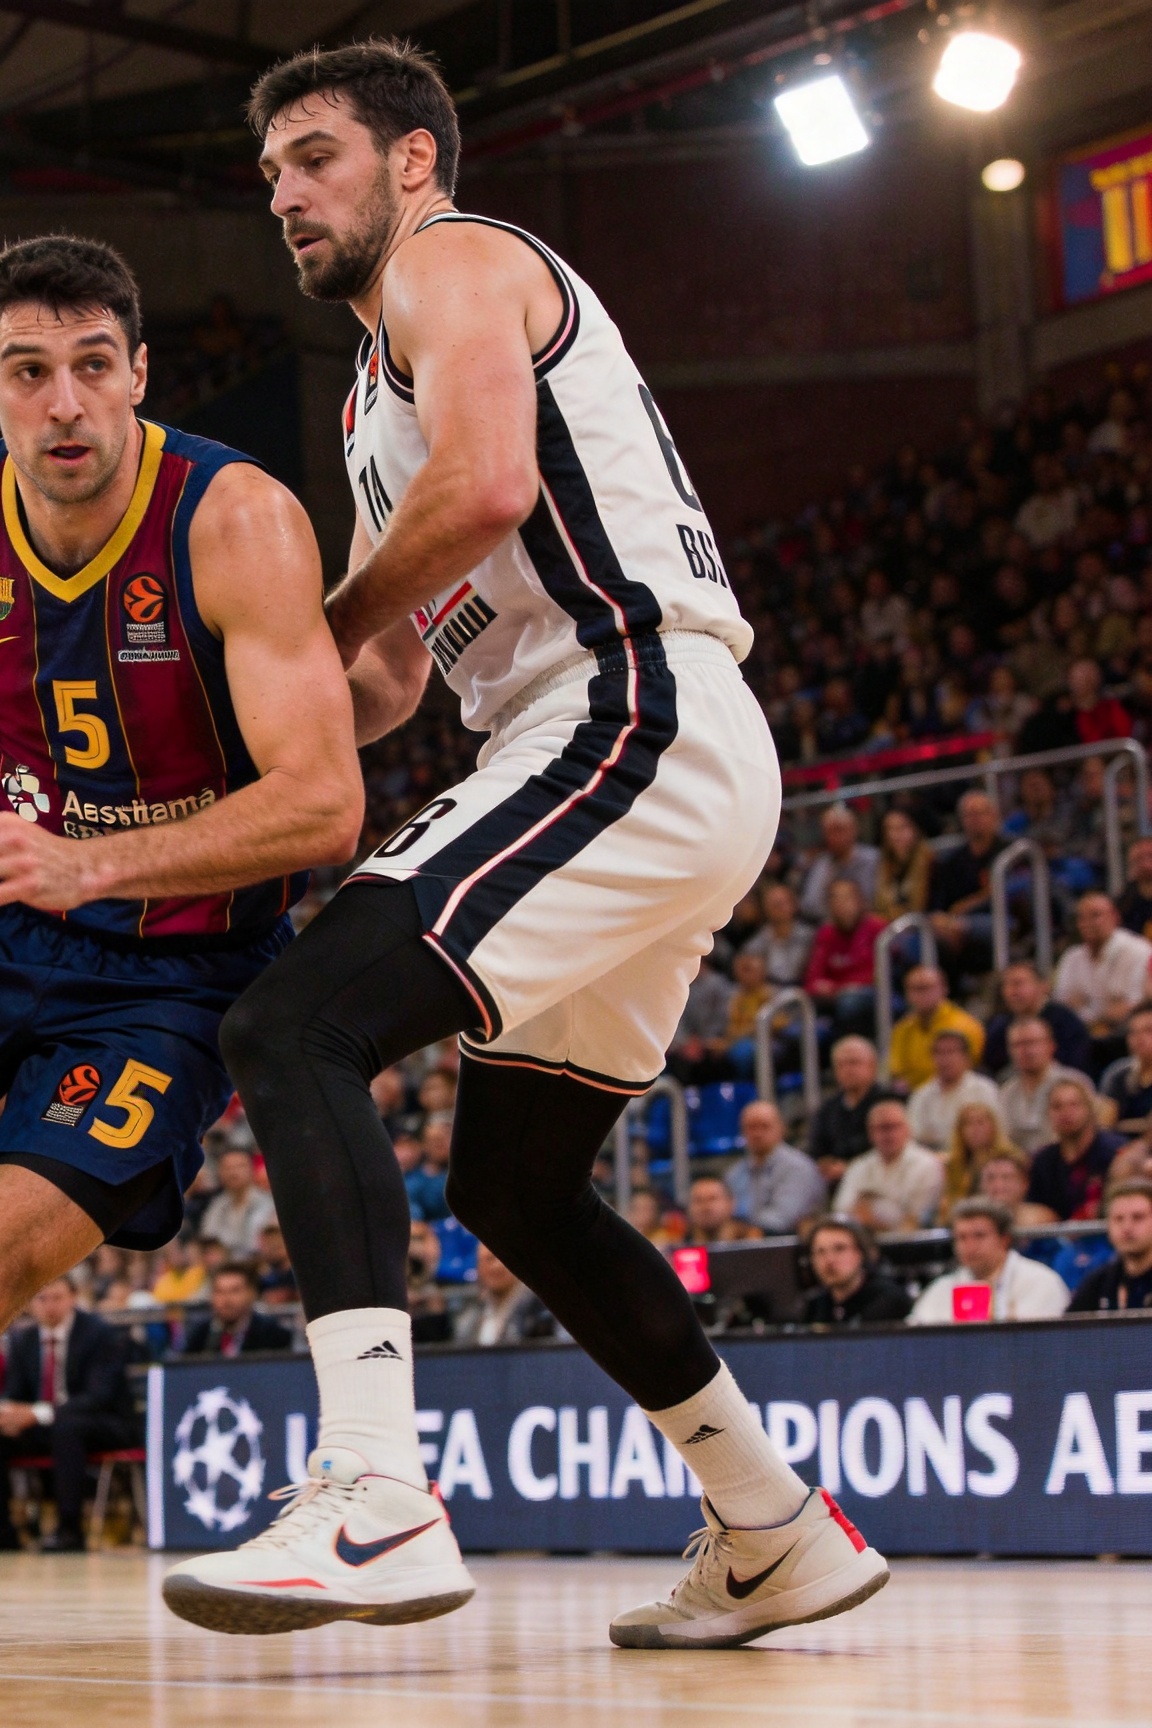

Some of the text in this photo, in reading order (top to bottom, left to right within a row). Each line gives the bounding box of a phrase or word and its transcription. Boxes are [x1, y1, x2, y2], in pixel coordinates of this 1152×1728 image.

[52, 680, 110, 769] 5
[374, 798, 457, 858] 6
[87, 1058, 173, 1149] 5
[285, 1408, 493, 1501] UFA
